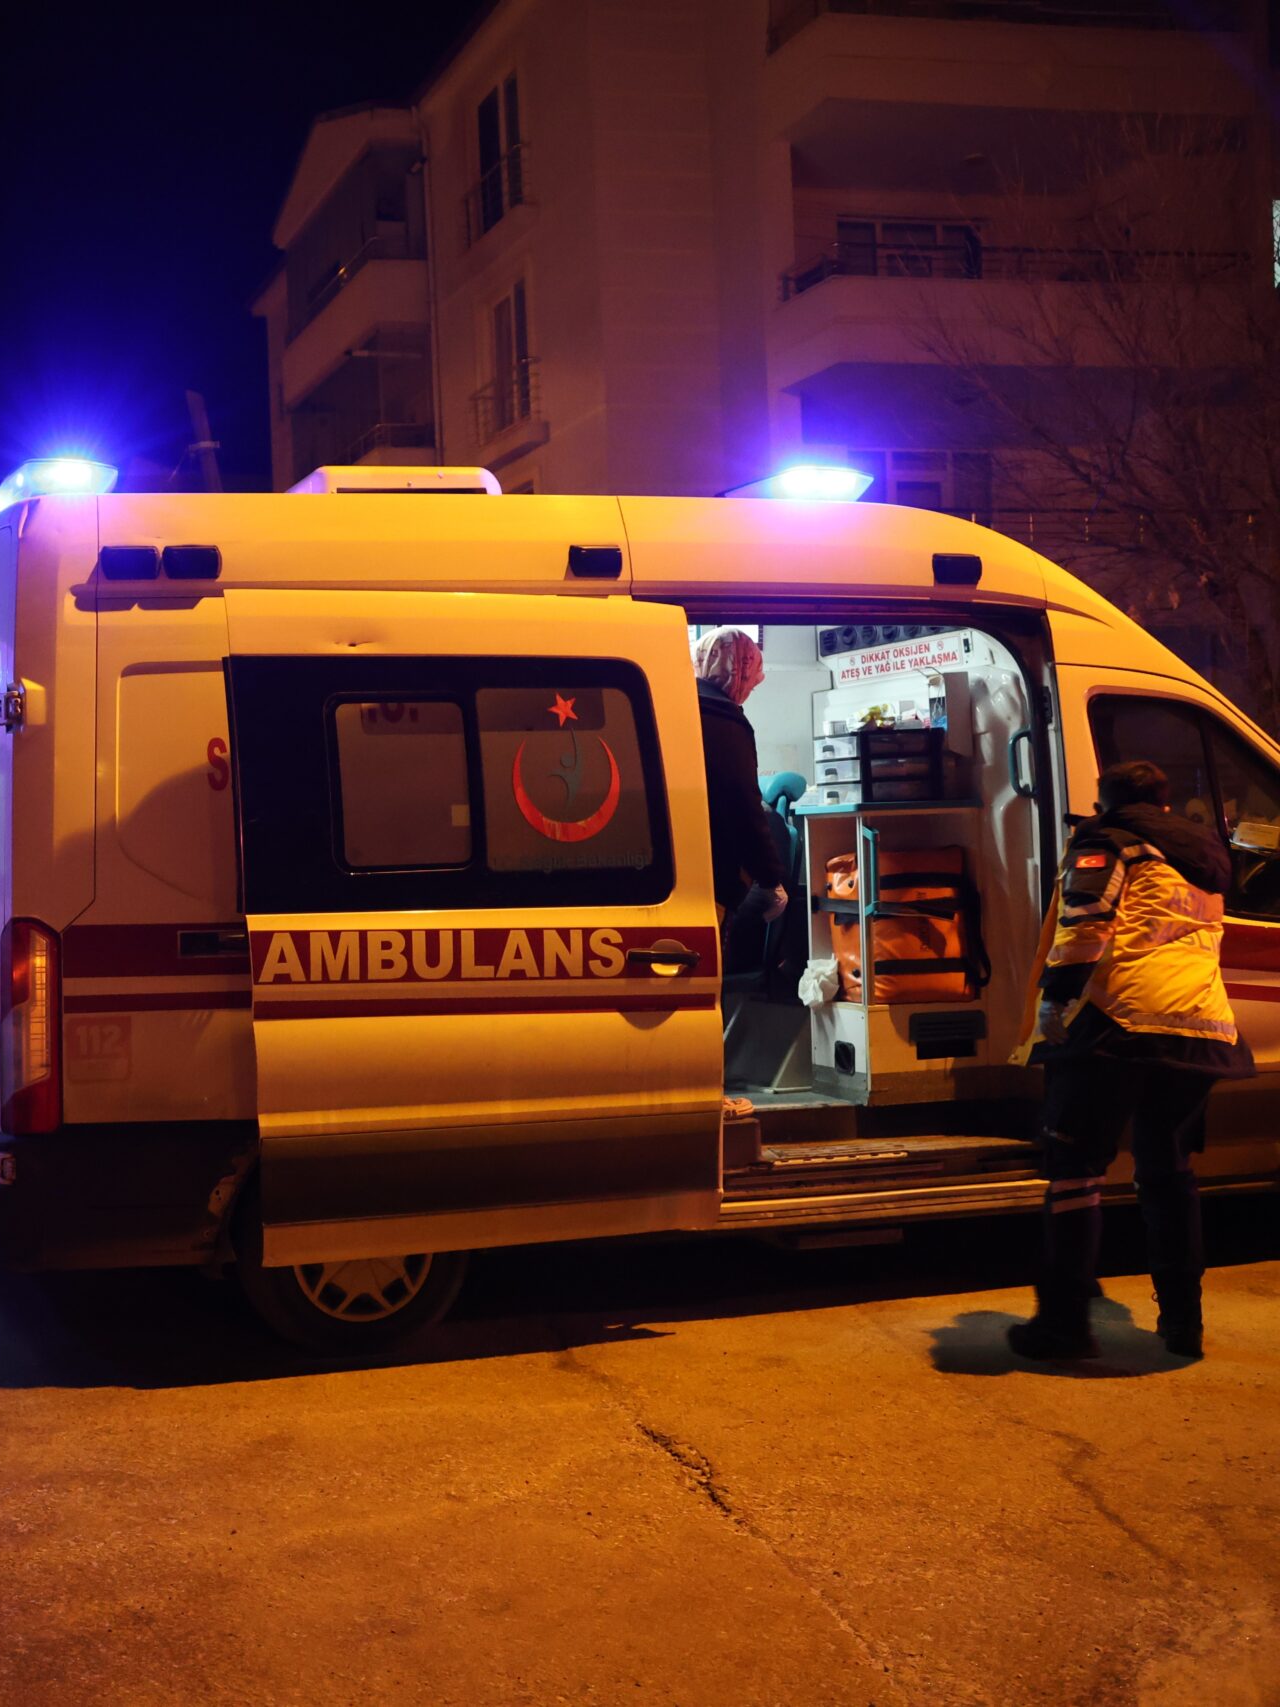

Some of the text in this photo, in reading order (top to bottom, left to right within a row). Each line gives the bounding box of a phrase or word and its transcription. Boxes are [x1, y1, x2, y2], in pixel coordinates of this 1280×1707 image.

[862, 666, 873, 676] VE
[257, 928, 625, 983] AMBULANS
[75, 1024, 124, 1055] 112
